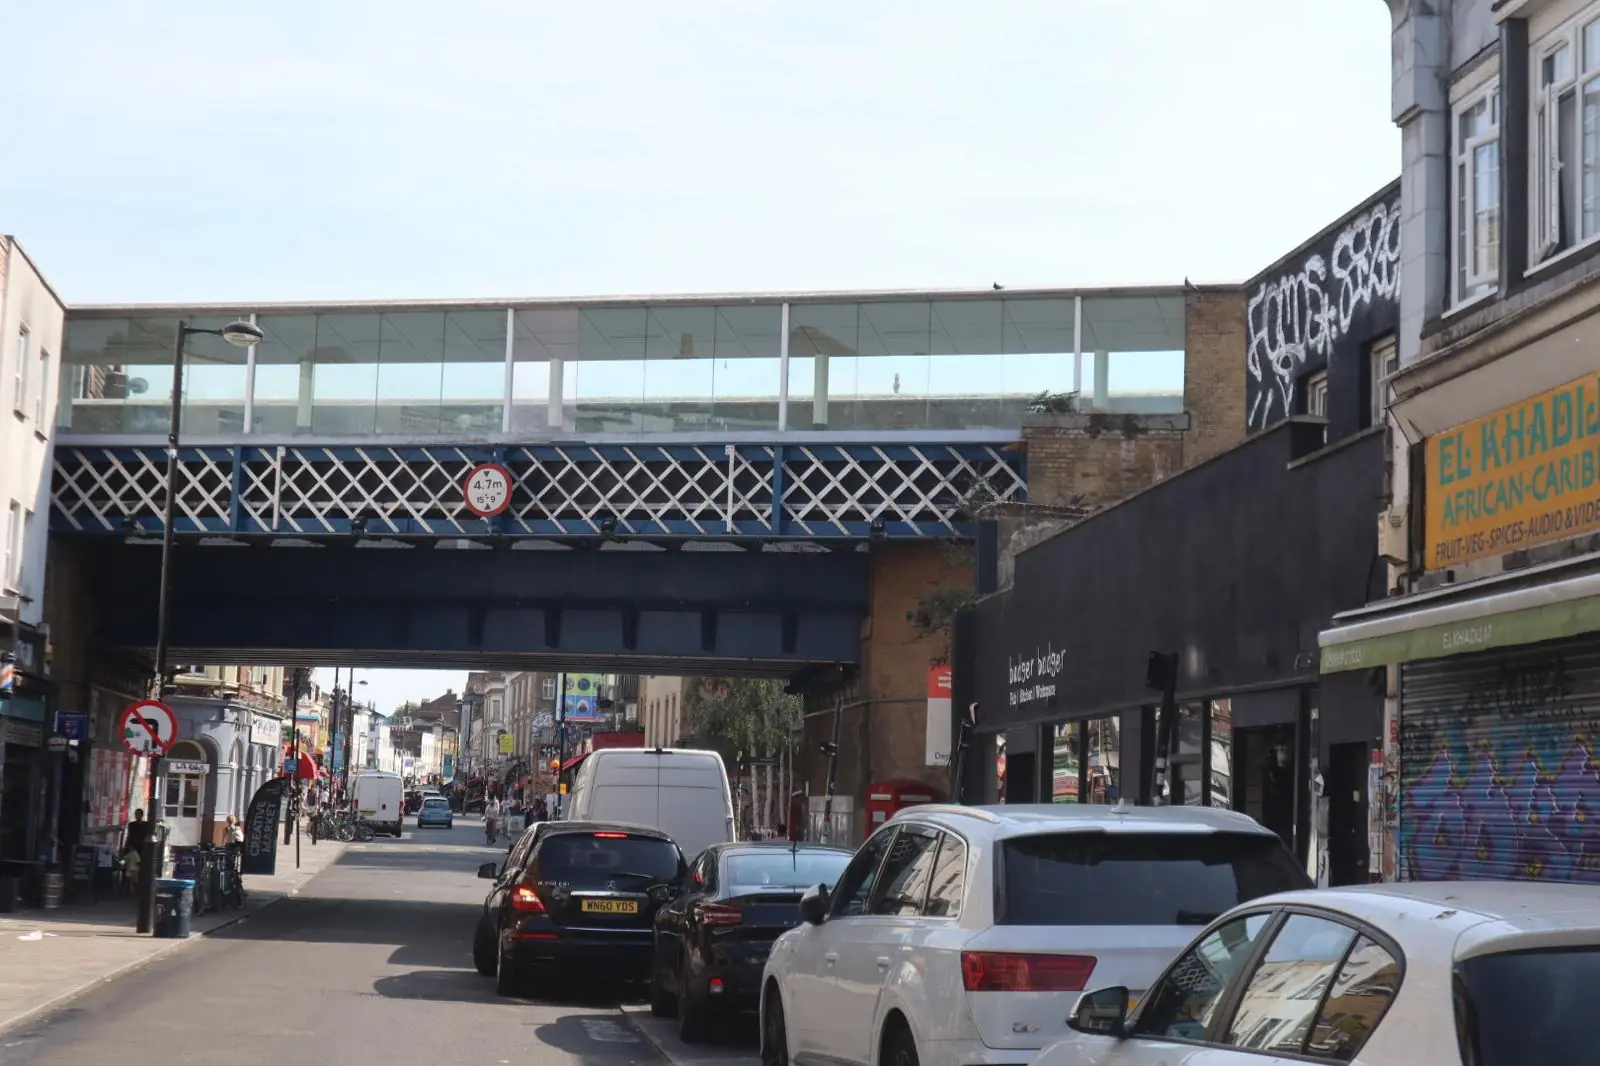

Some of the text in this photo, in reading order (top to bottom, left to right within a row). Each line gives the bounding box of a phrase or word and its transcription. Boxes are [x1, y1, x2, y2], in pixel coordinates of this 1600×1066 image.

[473, 479, 502, 490] 4.7m
[1442, 445, 1600, 529] AFRICAN-CARIB
[250, 800, 267, 856] CREATIVE
[261, 801, 277, 853] MARKET
[587, 900, 634, 912] WN60 YDS
